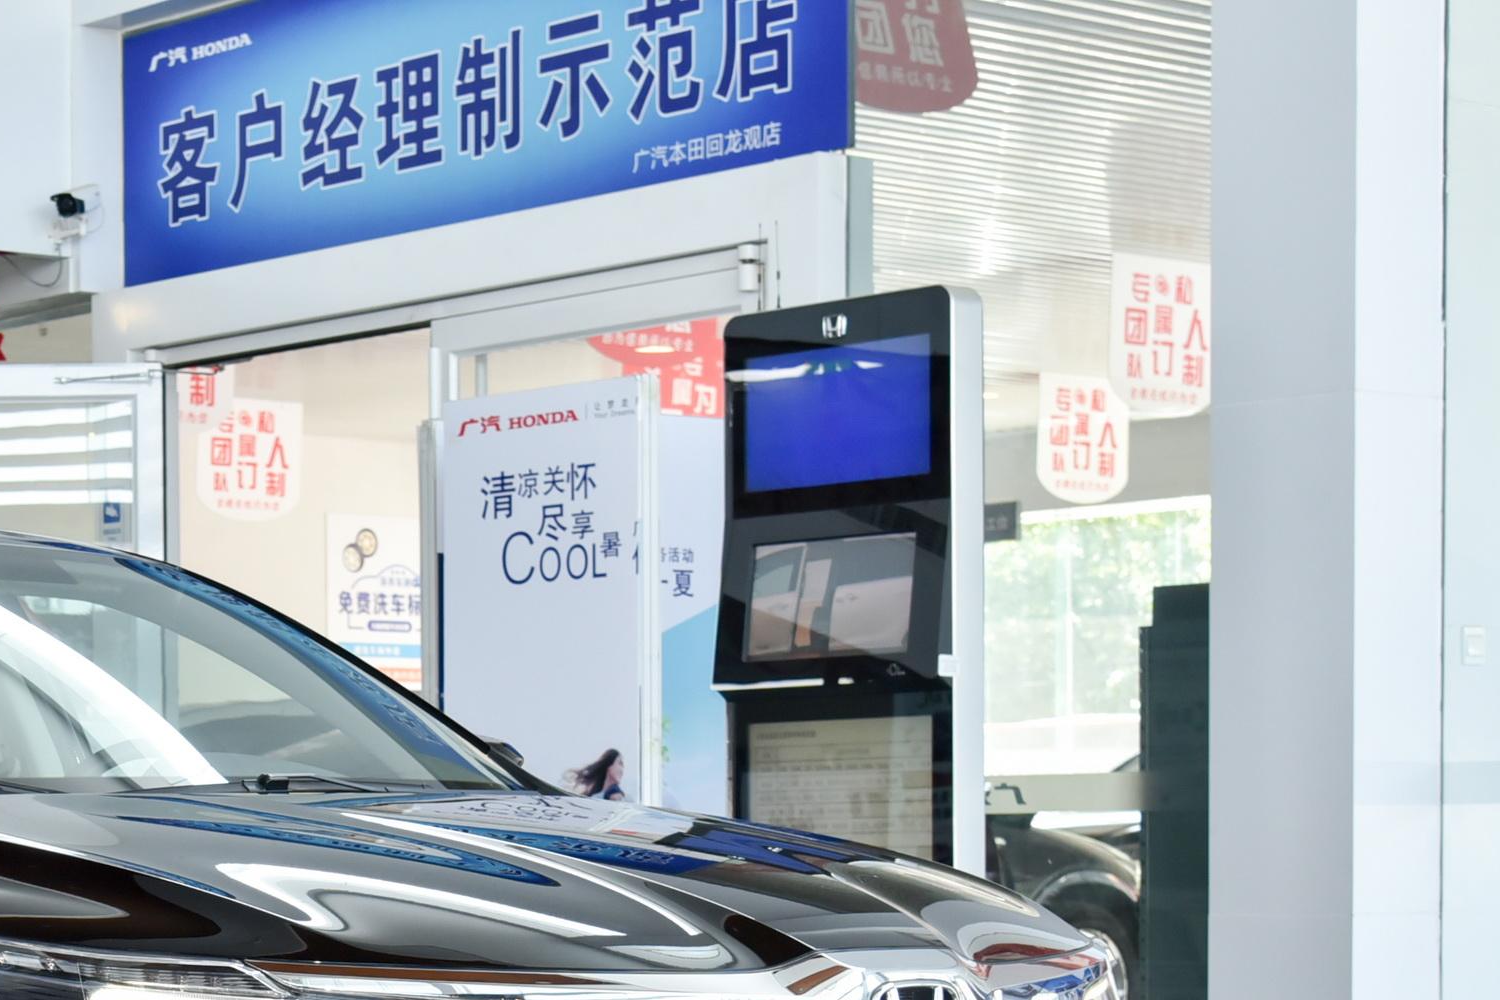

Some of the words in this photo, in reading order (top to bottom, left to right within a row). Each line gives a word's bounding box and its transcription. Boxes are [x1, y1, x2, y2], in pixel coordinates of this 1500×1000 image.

[148, 46, 188, 72] 广汽
[191, 33, 252, 60] HONDA
[157, 0, 798, 227] 客户经理制示范店
[632, 121, 782, 174] 广汽本田回龙观店
[458, 415, 502, 436] 广汽
[508, 410, 579, 430] HONDA
[480, 462, 597, 520] 清凉关怀
[537, 503, 595, 541] 尽享
